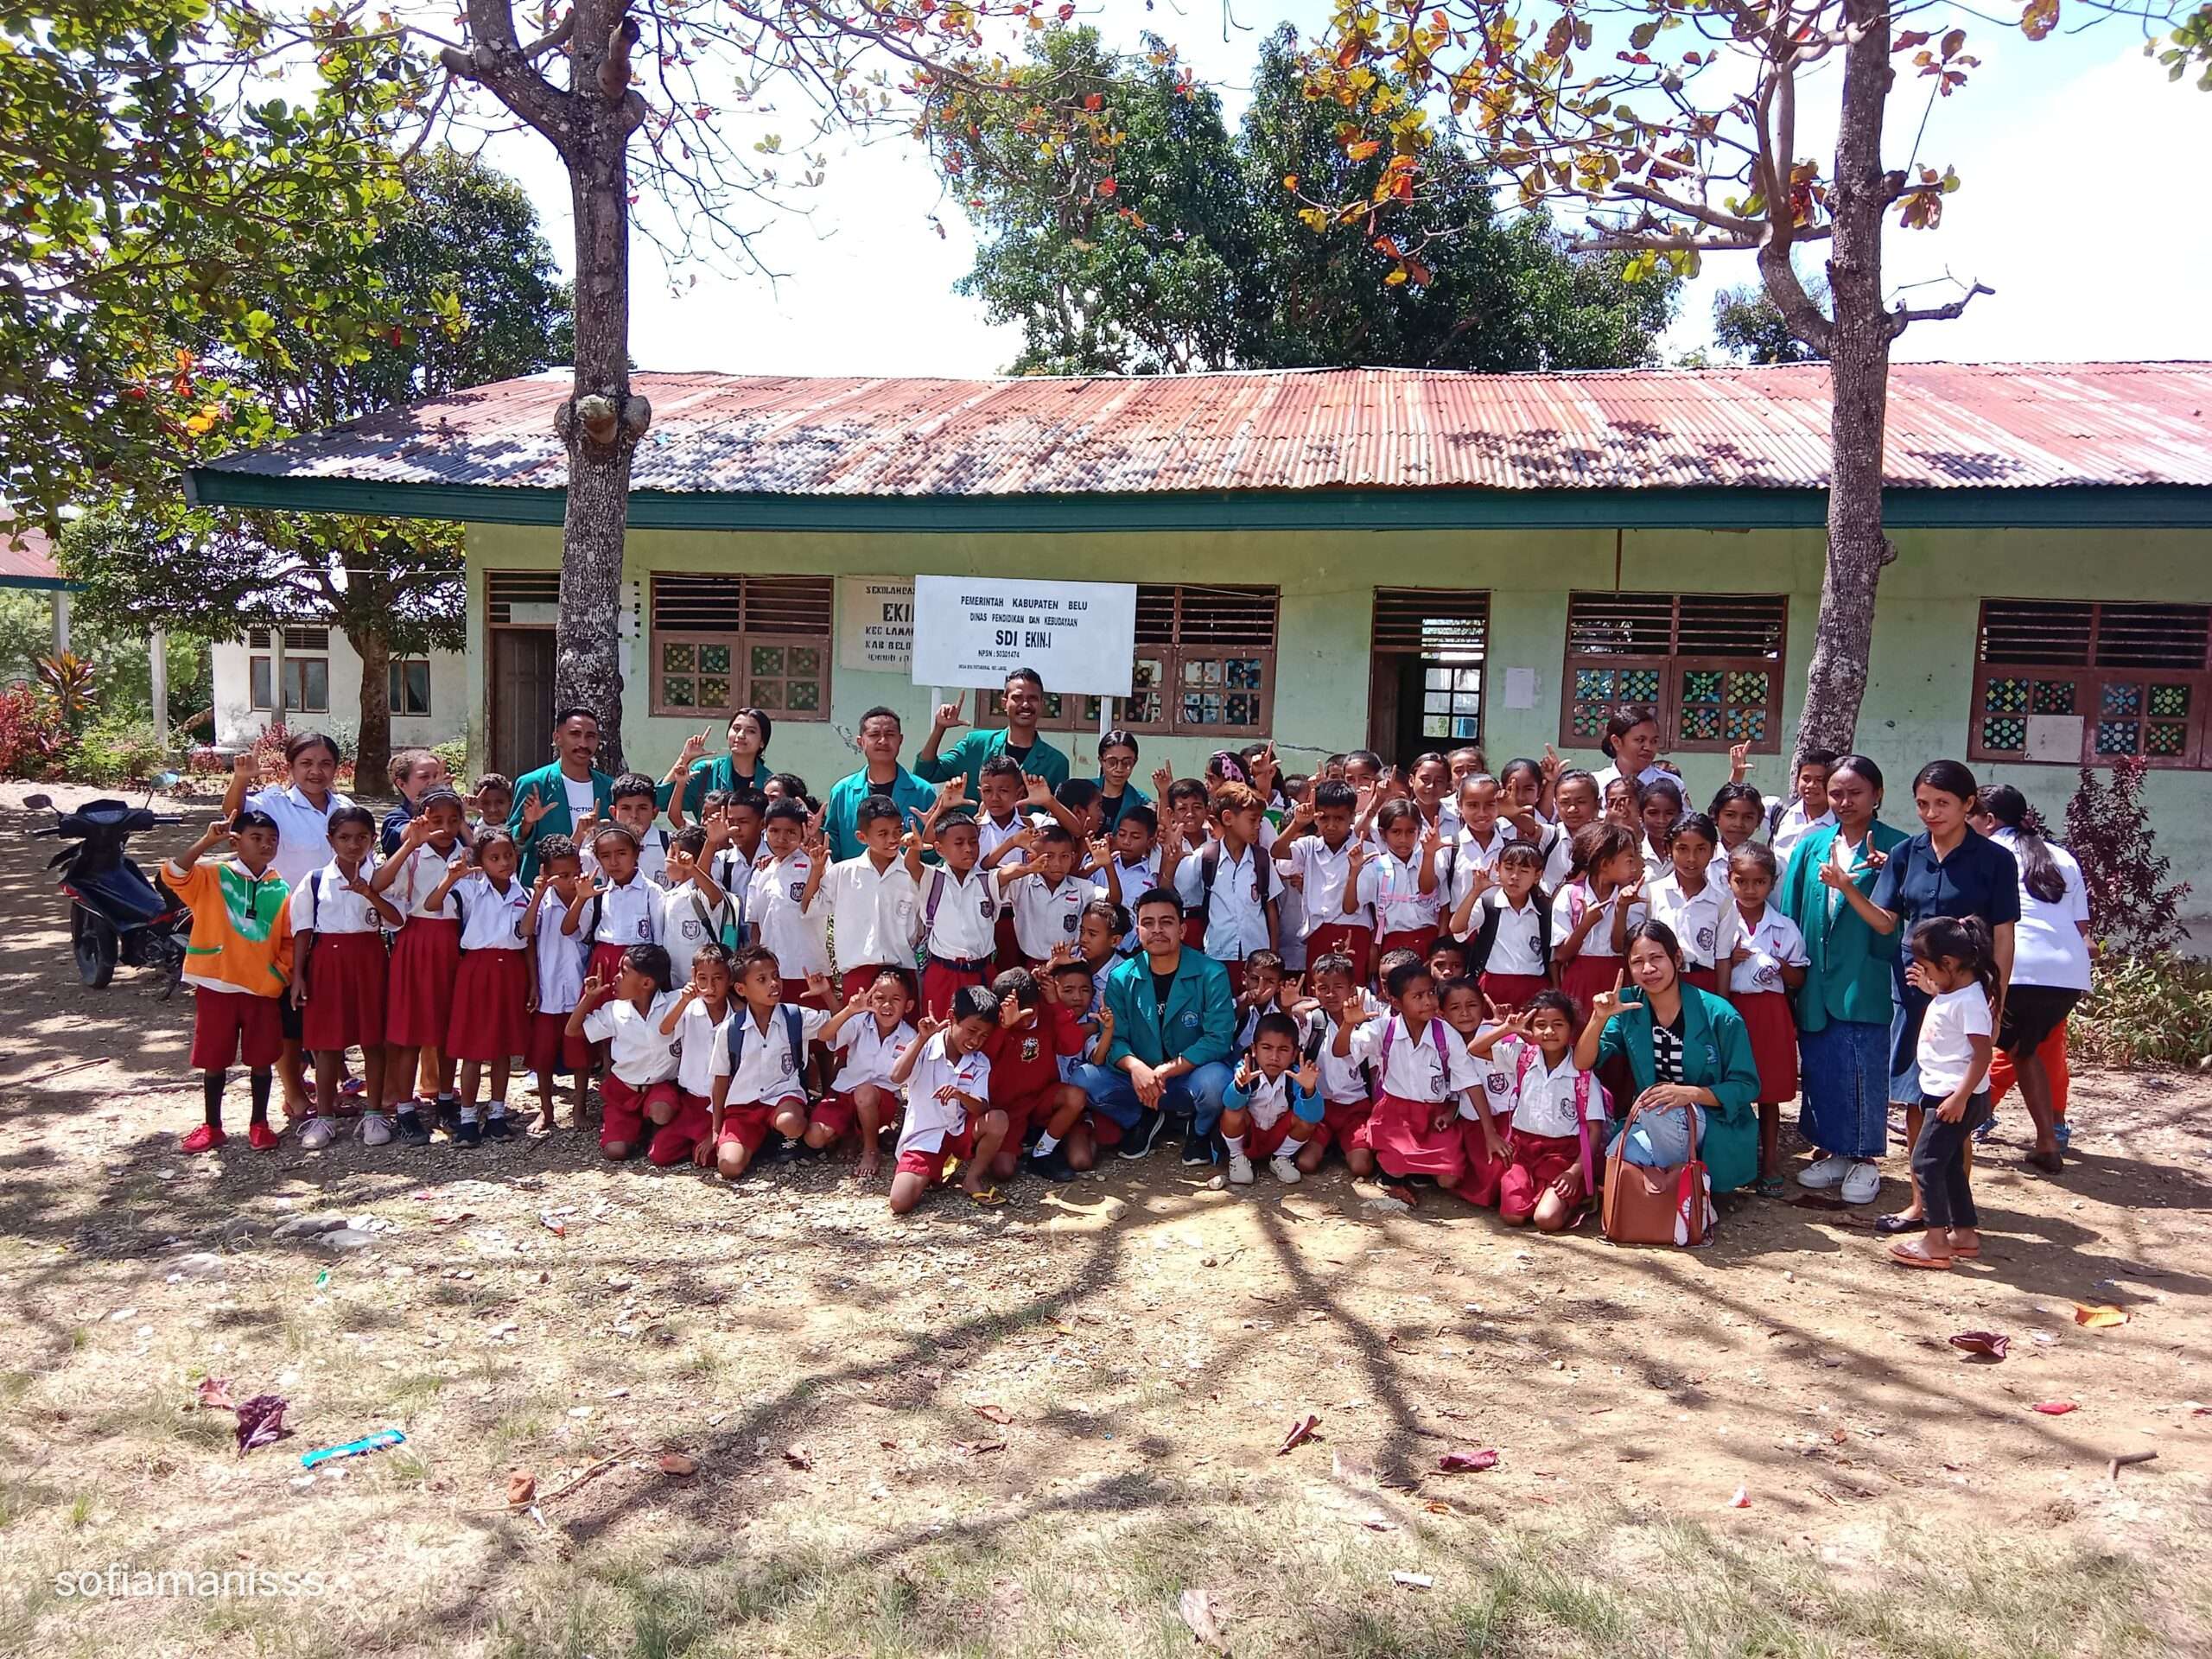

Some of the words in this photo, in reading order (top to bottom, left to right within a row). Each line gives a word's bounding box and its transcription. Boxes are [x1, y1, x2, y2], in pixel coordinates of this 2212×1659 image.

[961, 596, 1004, 607] PEMERINTAH
[1012, 598, 1058, 609] KABUPATEN
[1068, 601, 1088, 610] BELU
[969, 613, 987, 621] DINAS
[991, 613, 1024, 623] PENDIDIKAN
[1044, 616, 1078, 627] KEBUDAYAAN
[865, 640, 884, 649] KAB
[995, 630, 1018, 646] SDI
